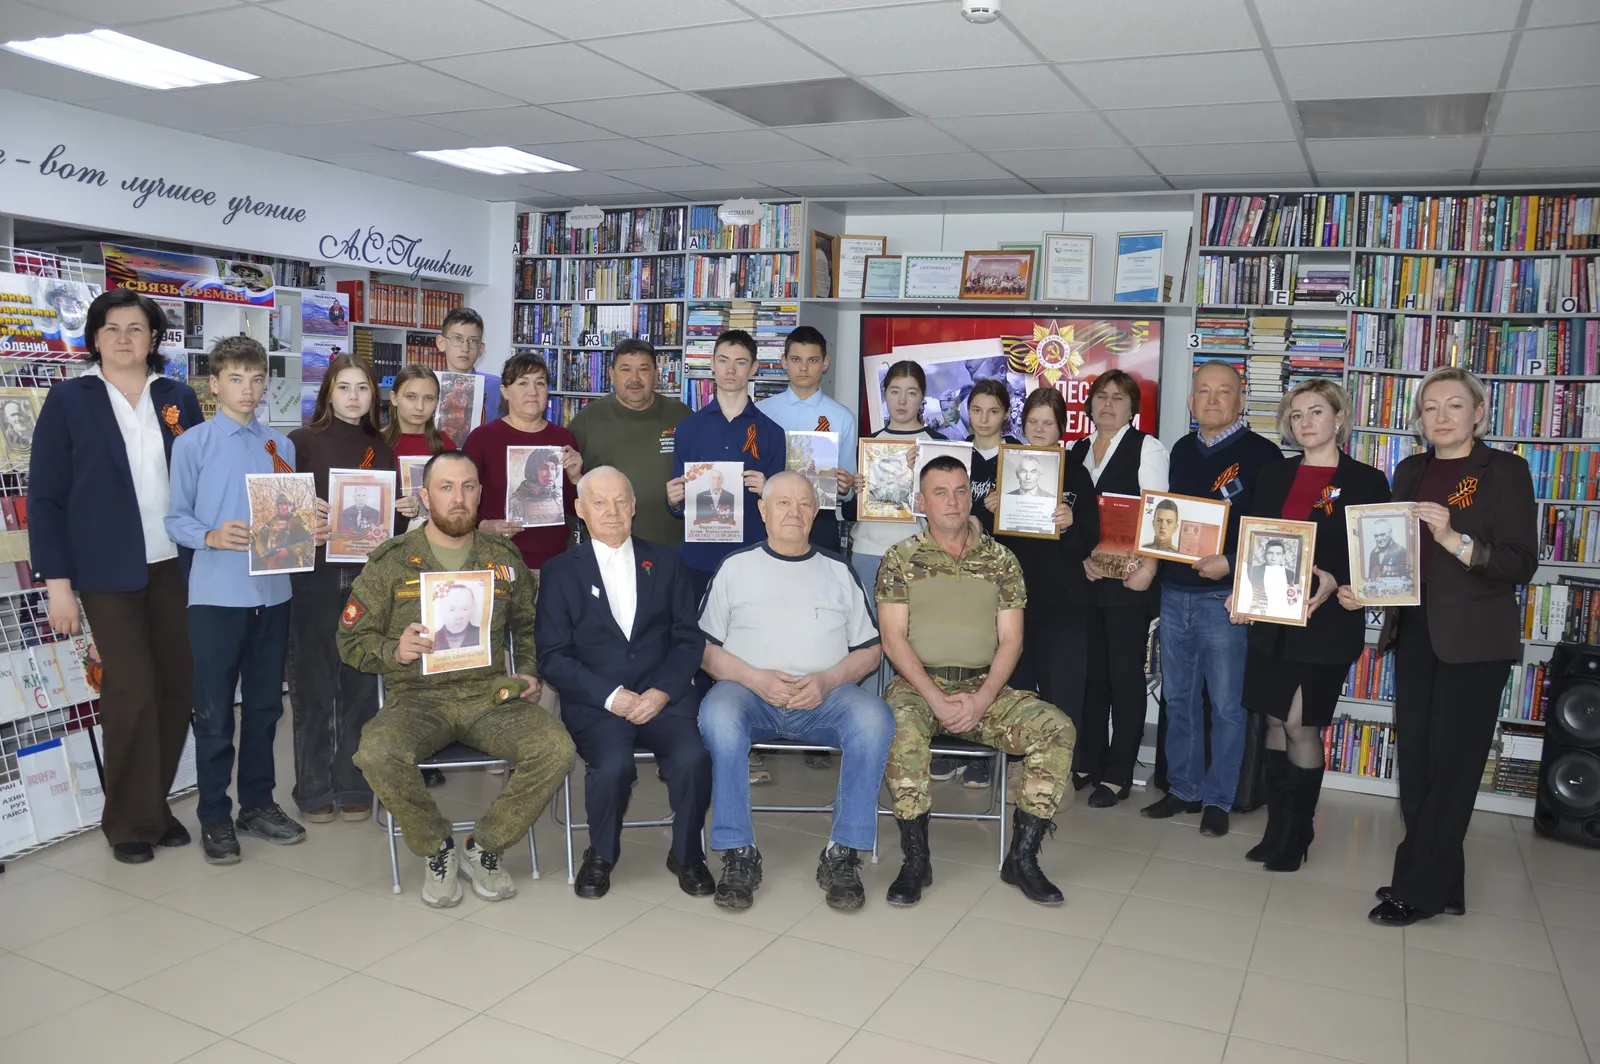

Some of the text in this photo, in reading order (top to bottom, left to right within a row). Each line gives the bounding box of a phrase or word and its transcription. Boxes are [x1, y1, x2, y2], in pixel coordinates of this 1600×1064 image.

[39, 144, 108, 187] вот
[121, 176, 216, 209] лучшее
[222, 195, 307, 225] учение
[512, 244, 519, 254] А
[690, 238, 698, 249] А
[117, 280, 180, 295] «СВЯЗЬ
[537, 288, 543, 299] В
[586, 289, 594, 299] Г
[1275, 291, 1287, 304] Е
[1340, 291, 1356, 304] Ж
[1405, 294, 1416, 309] Н
[1562, 298, 1576, 312] О
[0, 327, 42, 337] ерация
[161, 331, 182, 343] 945
[1530, 361, 1541, 374] Р
[1055, 380, 1093, 404] ПЕС
[1370, 611, 1382, 624] Х
